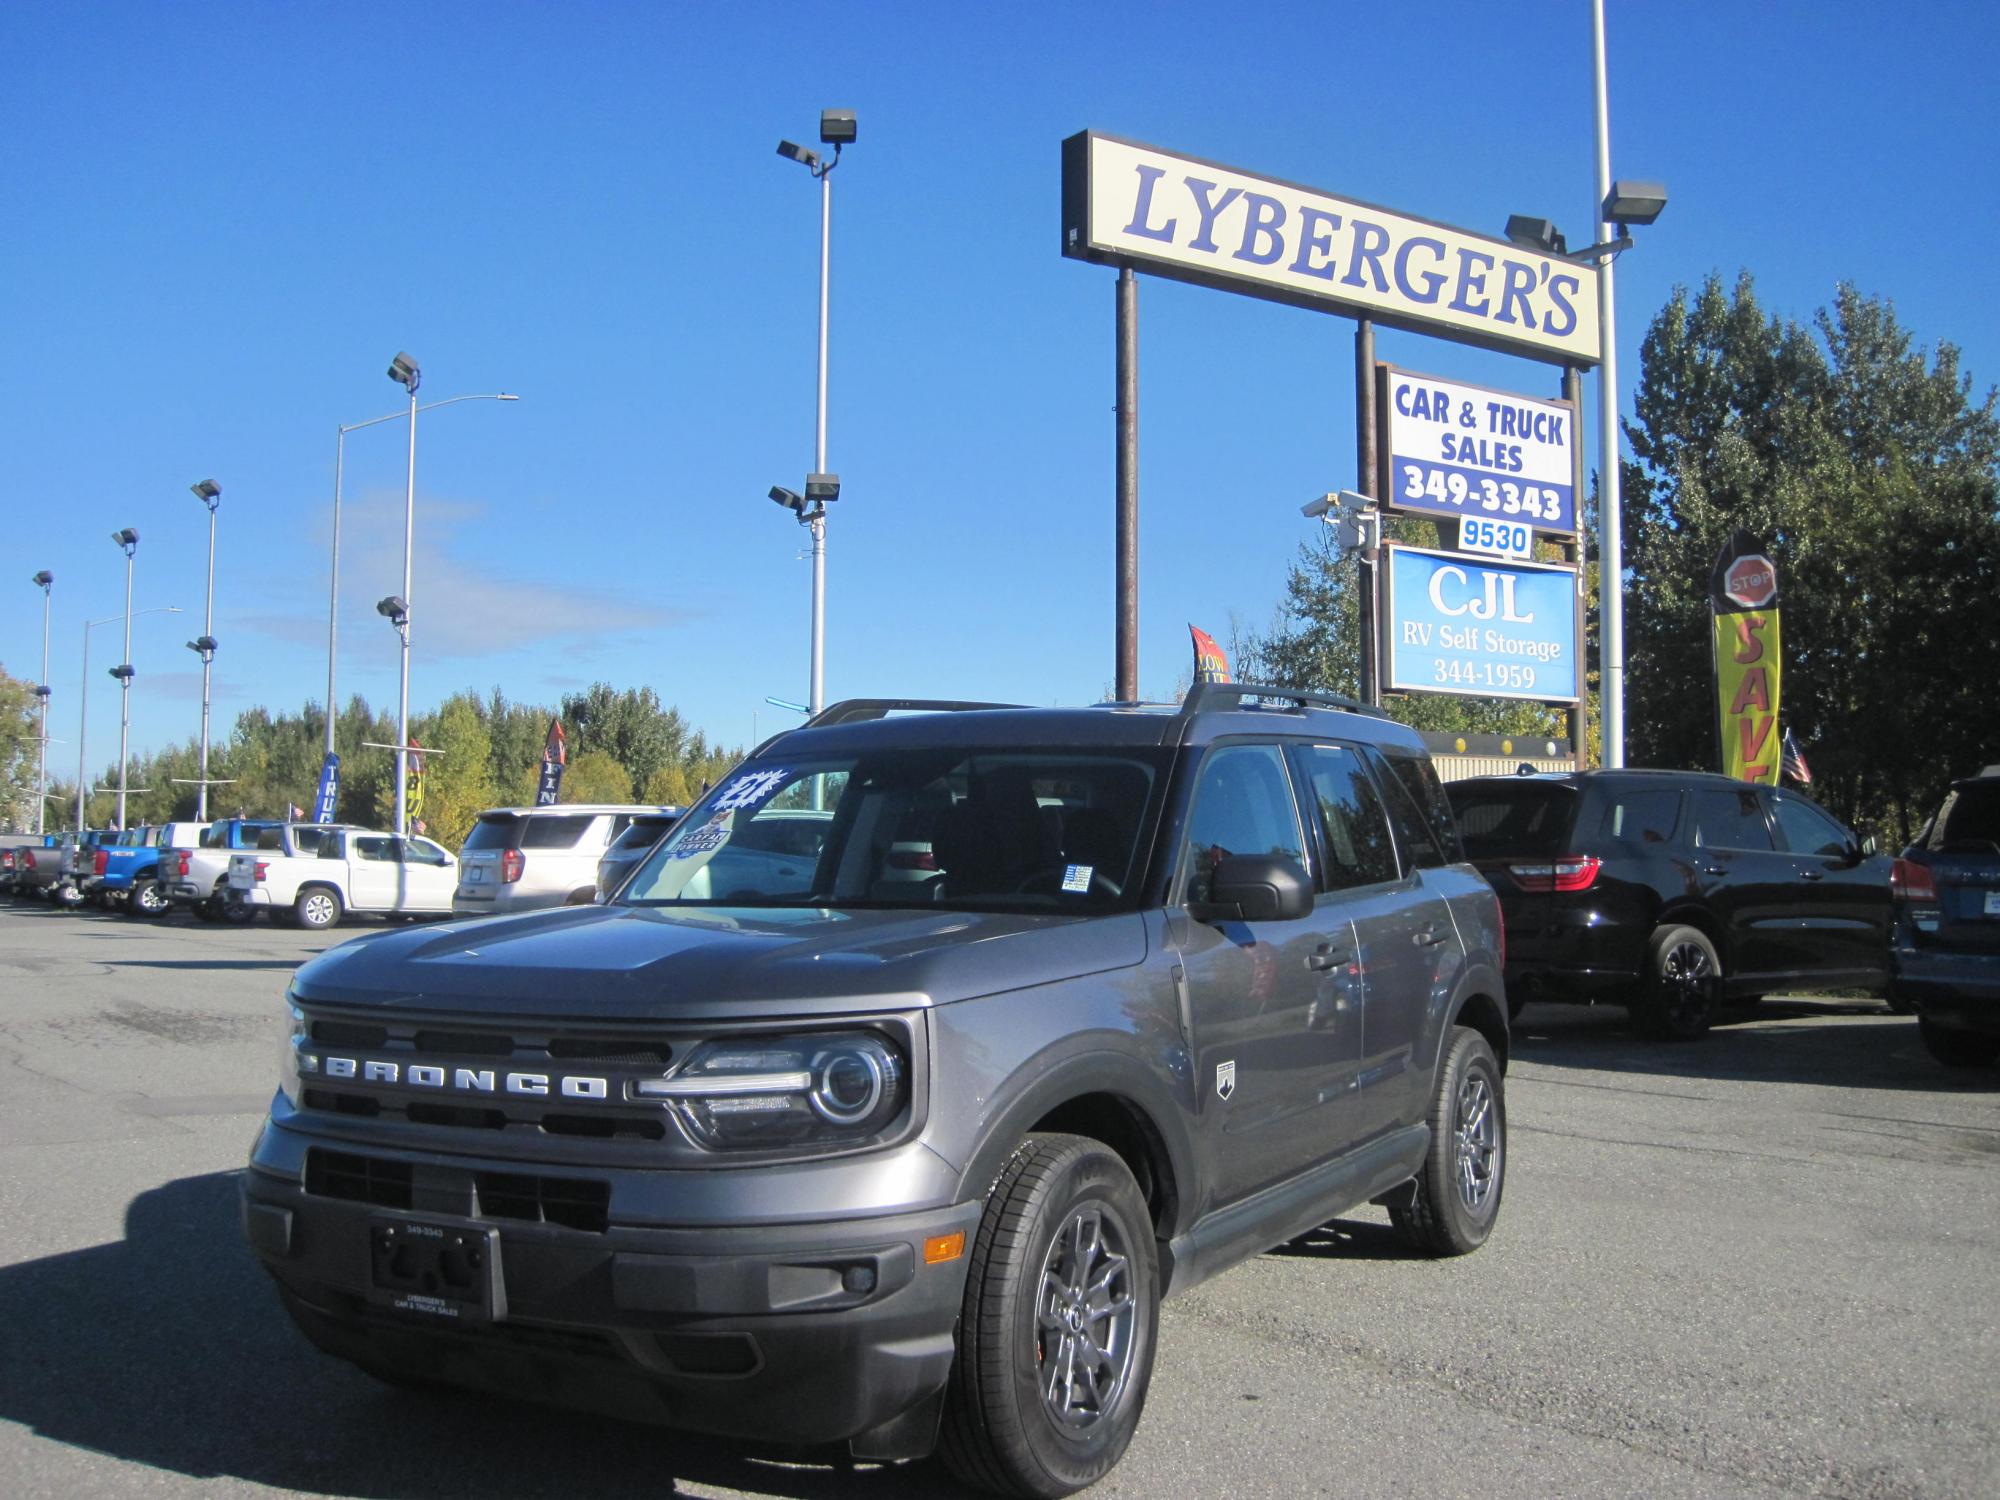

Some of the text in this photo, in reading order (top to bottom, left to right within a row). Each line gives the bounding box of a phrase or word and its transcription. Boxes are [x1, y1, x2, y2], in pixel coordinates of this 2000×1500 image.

[1123, 164, 1580, 337] LYBERGER'S
[1395, 383, 1564, 446] CAR & TRUCK
[1441, 432, 1523, 473] SALES
[1403, 465, 1561, 521] 349-3343
[1464, 519, 1527, 552] 9530
[1428, 566, 1534, 624] CJL
[1731, 571, 1771, 592] STOP
[1403, 620, 1561, 662] RV Self Storage
[1434, 658, 1536, 689] 344-1959
[326, 1057, 607, 1099] BRONCO
